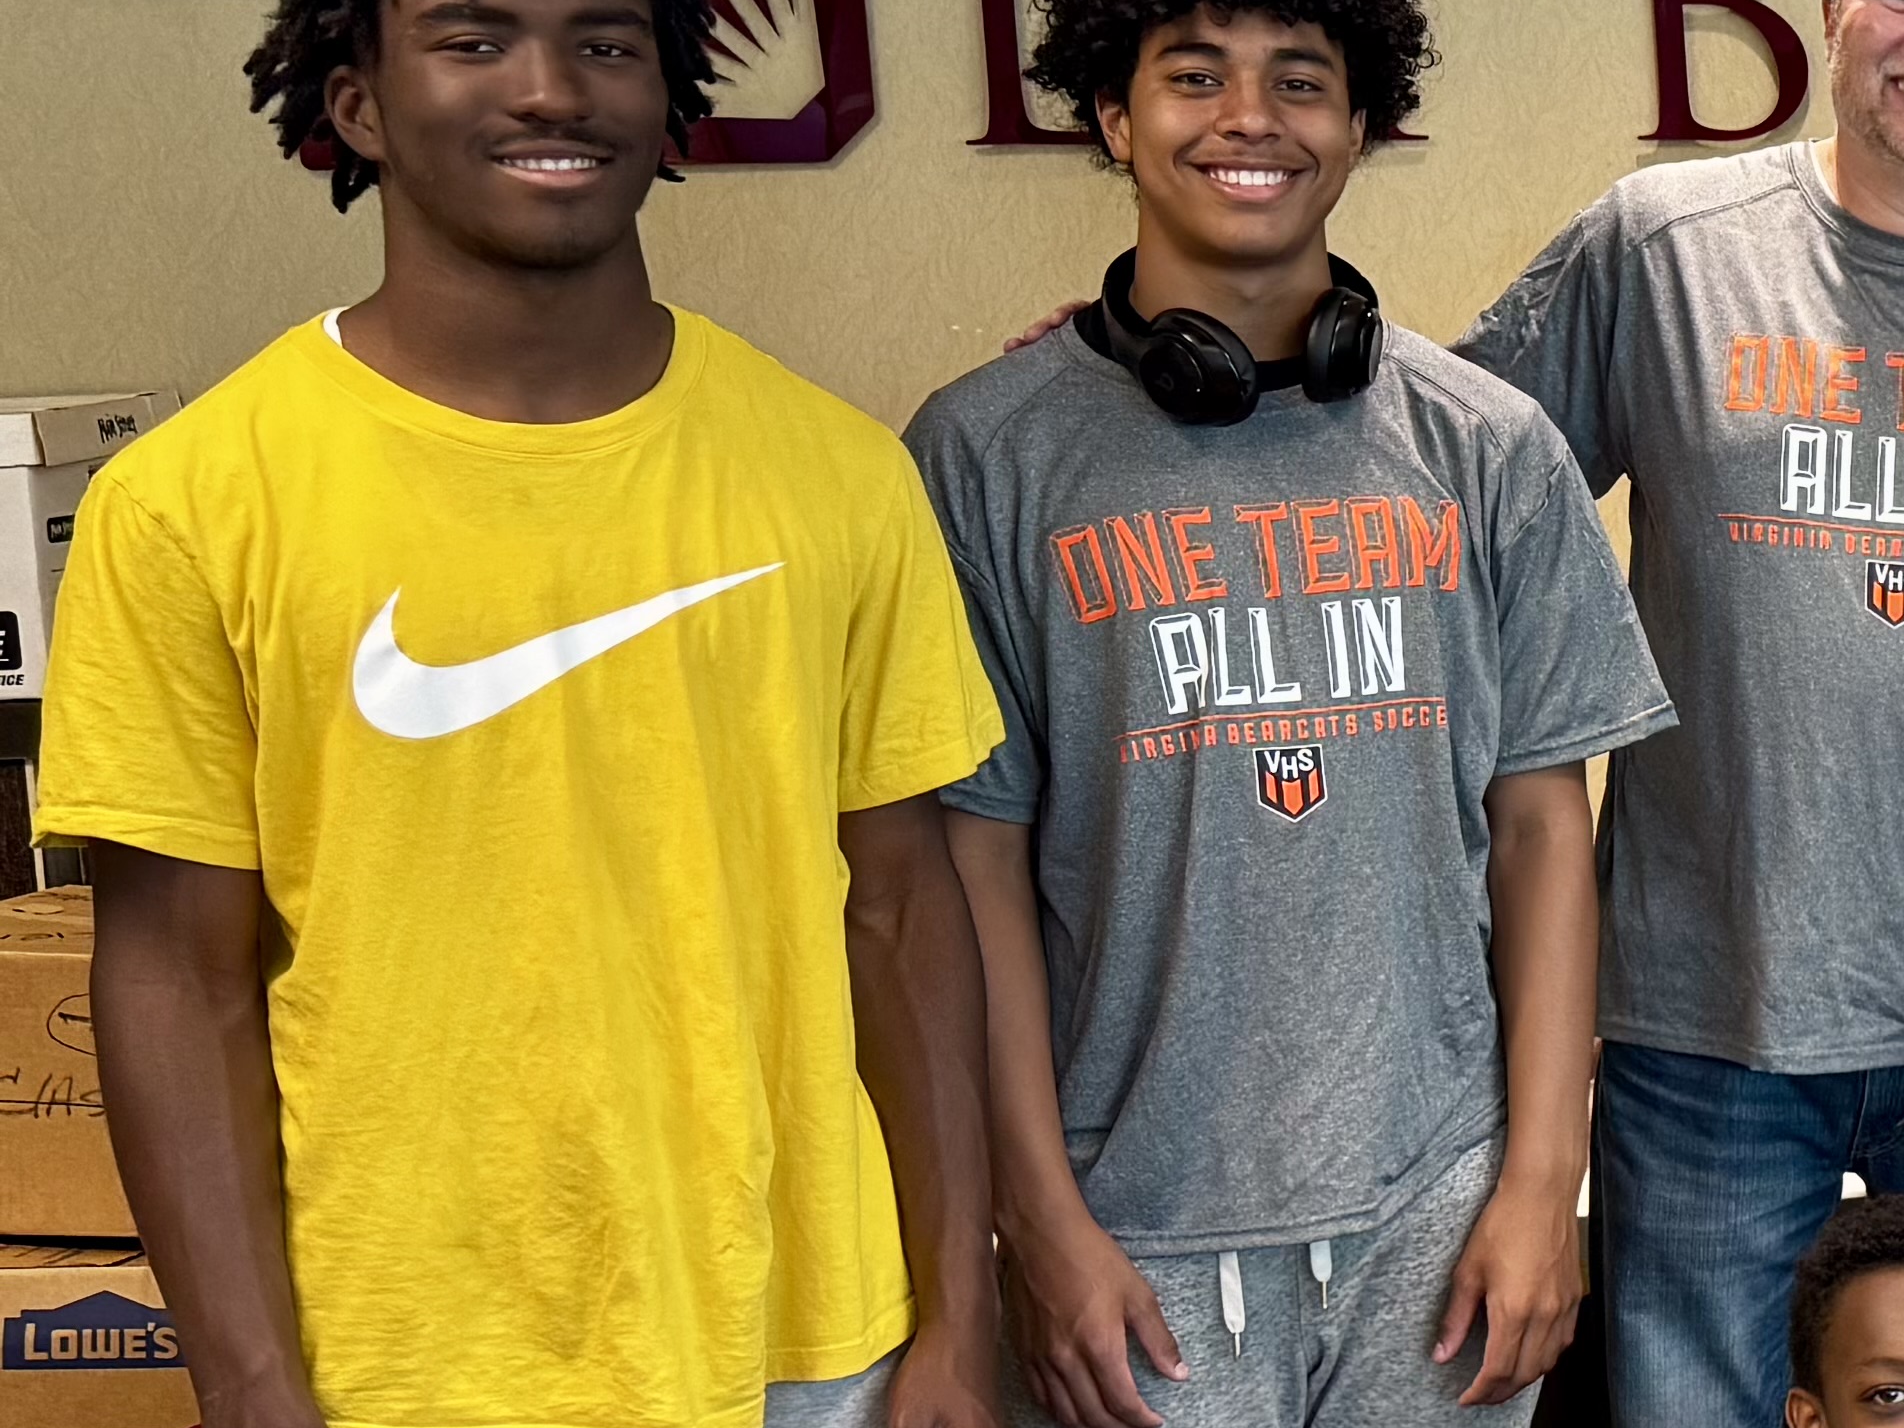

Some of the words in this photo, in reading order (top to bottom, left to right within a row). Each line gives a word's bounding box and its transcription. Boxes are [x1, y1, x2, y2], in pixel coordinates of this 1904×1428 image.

[1723, 332, 1867, 425] ONE
[1049, 507, 1228, 625] ONE
[1233, 495, 1461, 598] TEAM
[1148, 606, 1302, 715] ALL
[1320, 596, 1406, 699] IN
[1372, 705, 1448, 733] SOCCE
[1263, 747, 1315, 780] VHS
[24, 1322, 179, 1361] LOWE'S
